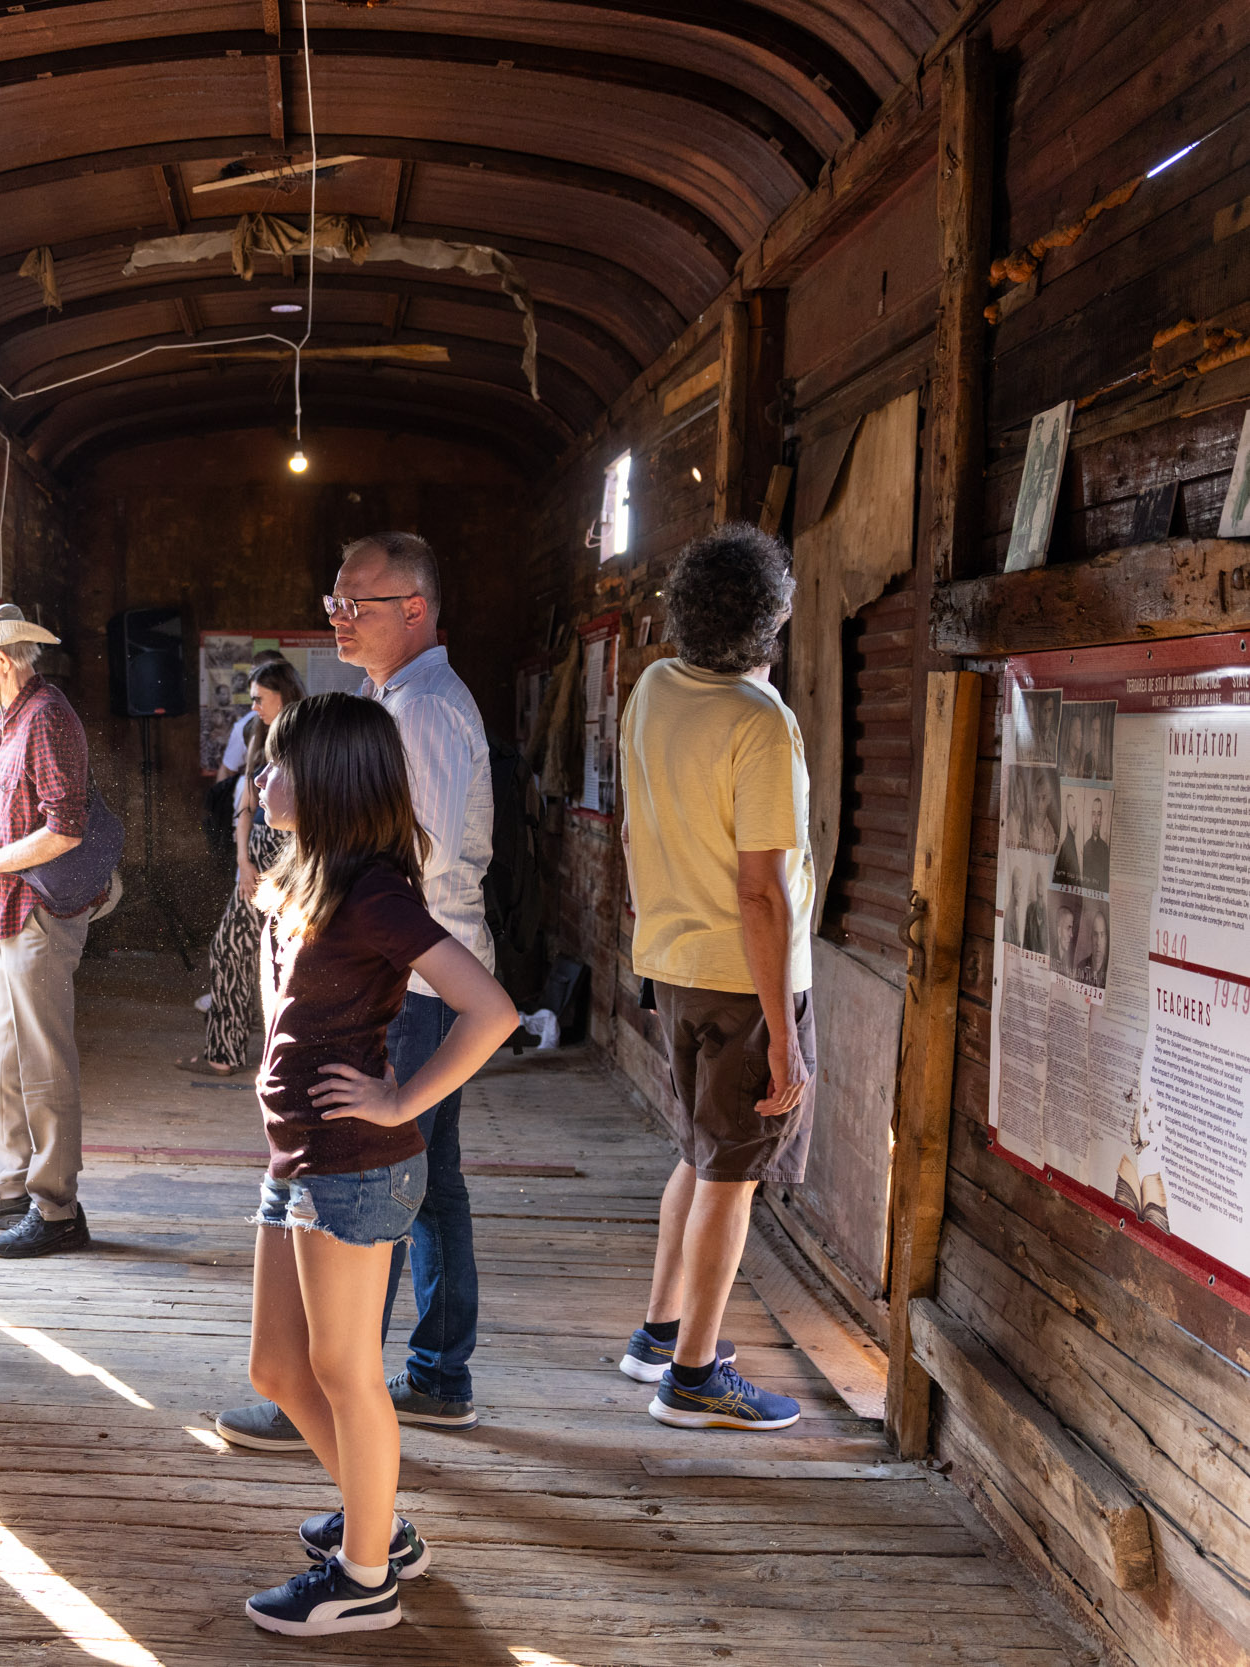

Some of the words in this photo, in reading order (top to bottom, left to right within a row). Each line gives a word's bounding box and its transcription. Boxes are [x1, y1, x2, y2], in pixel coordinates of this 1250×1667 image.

[1155, 676, 1167, 692] STAT
[1232, 674, 1250, 688] STATE
[1197, 693, 1222, 705] AMPLOARE
[1169, 727, 1238, 764] ÎNVĂȚĂTORI
[1156, 928, 1187, 961] 1940
[1156, 987, 1211, 1027] TEACHERS
[1214, 978, 1250, 1015] 1949
